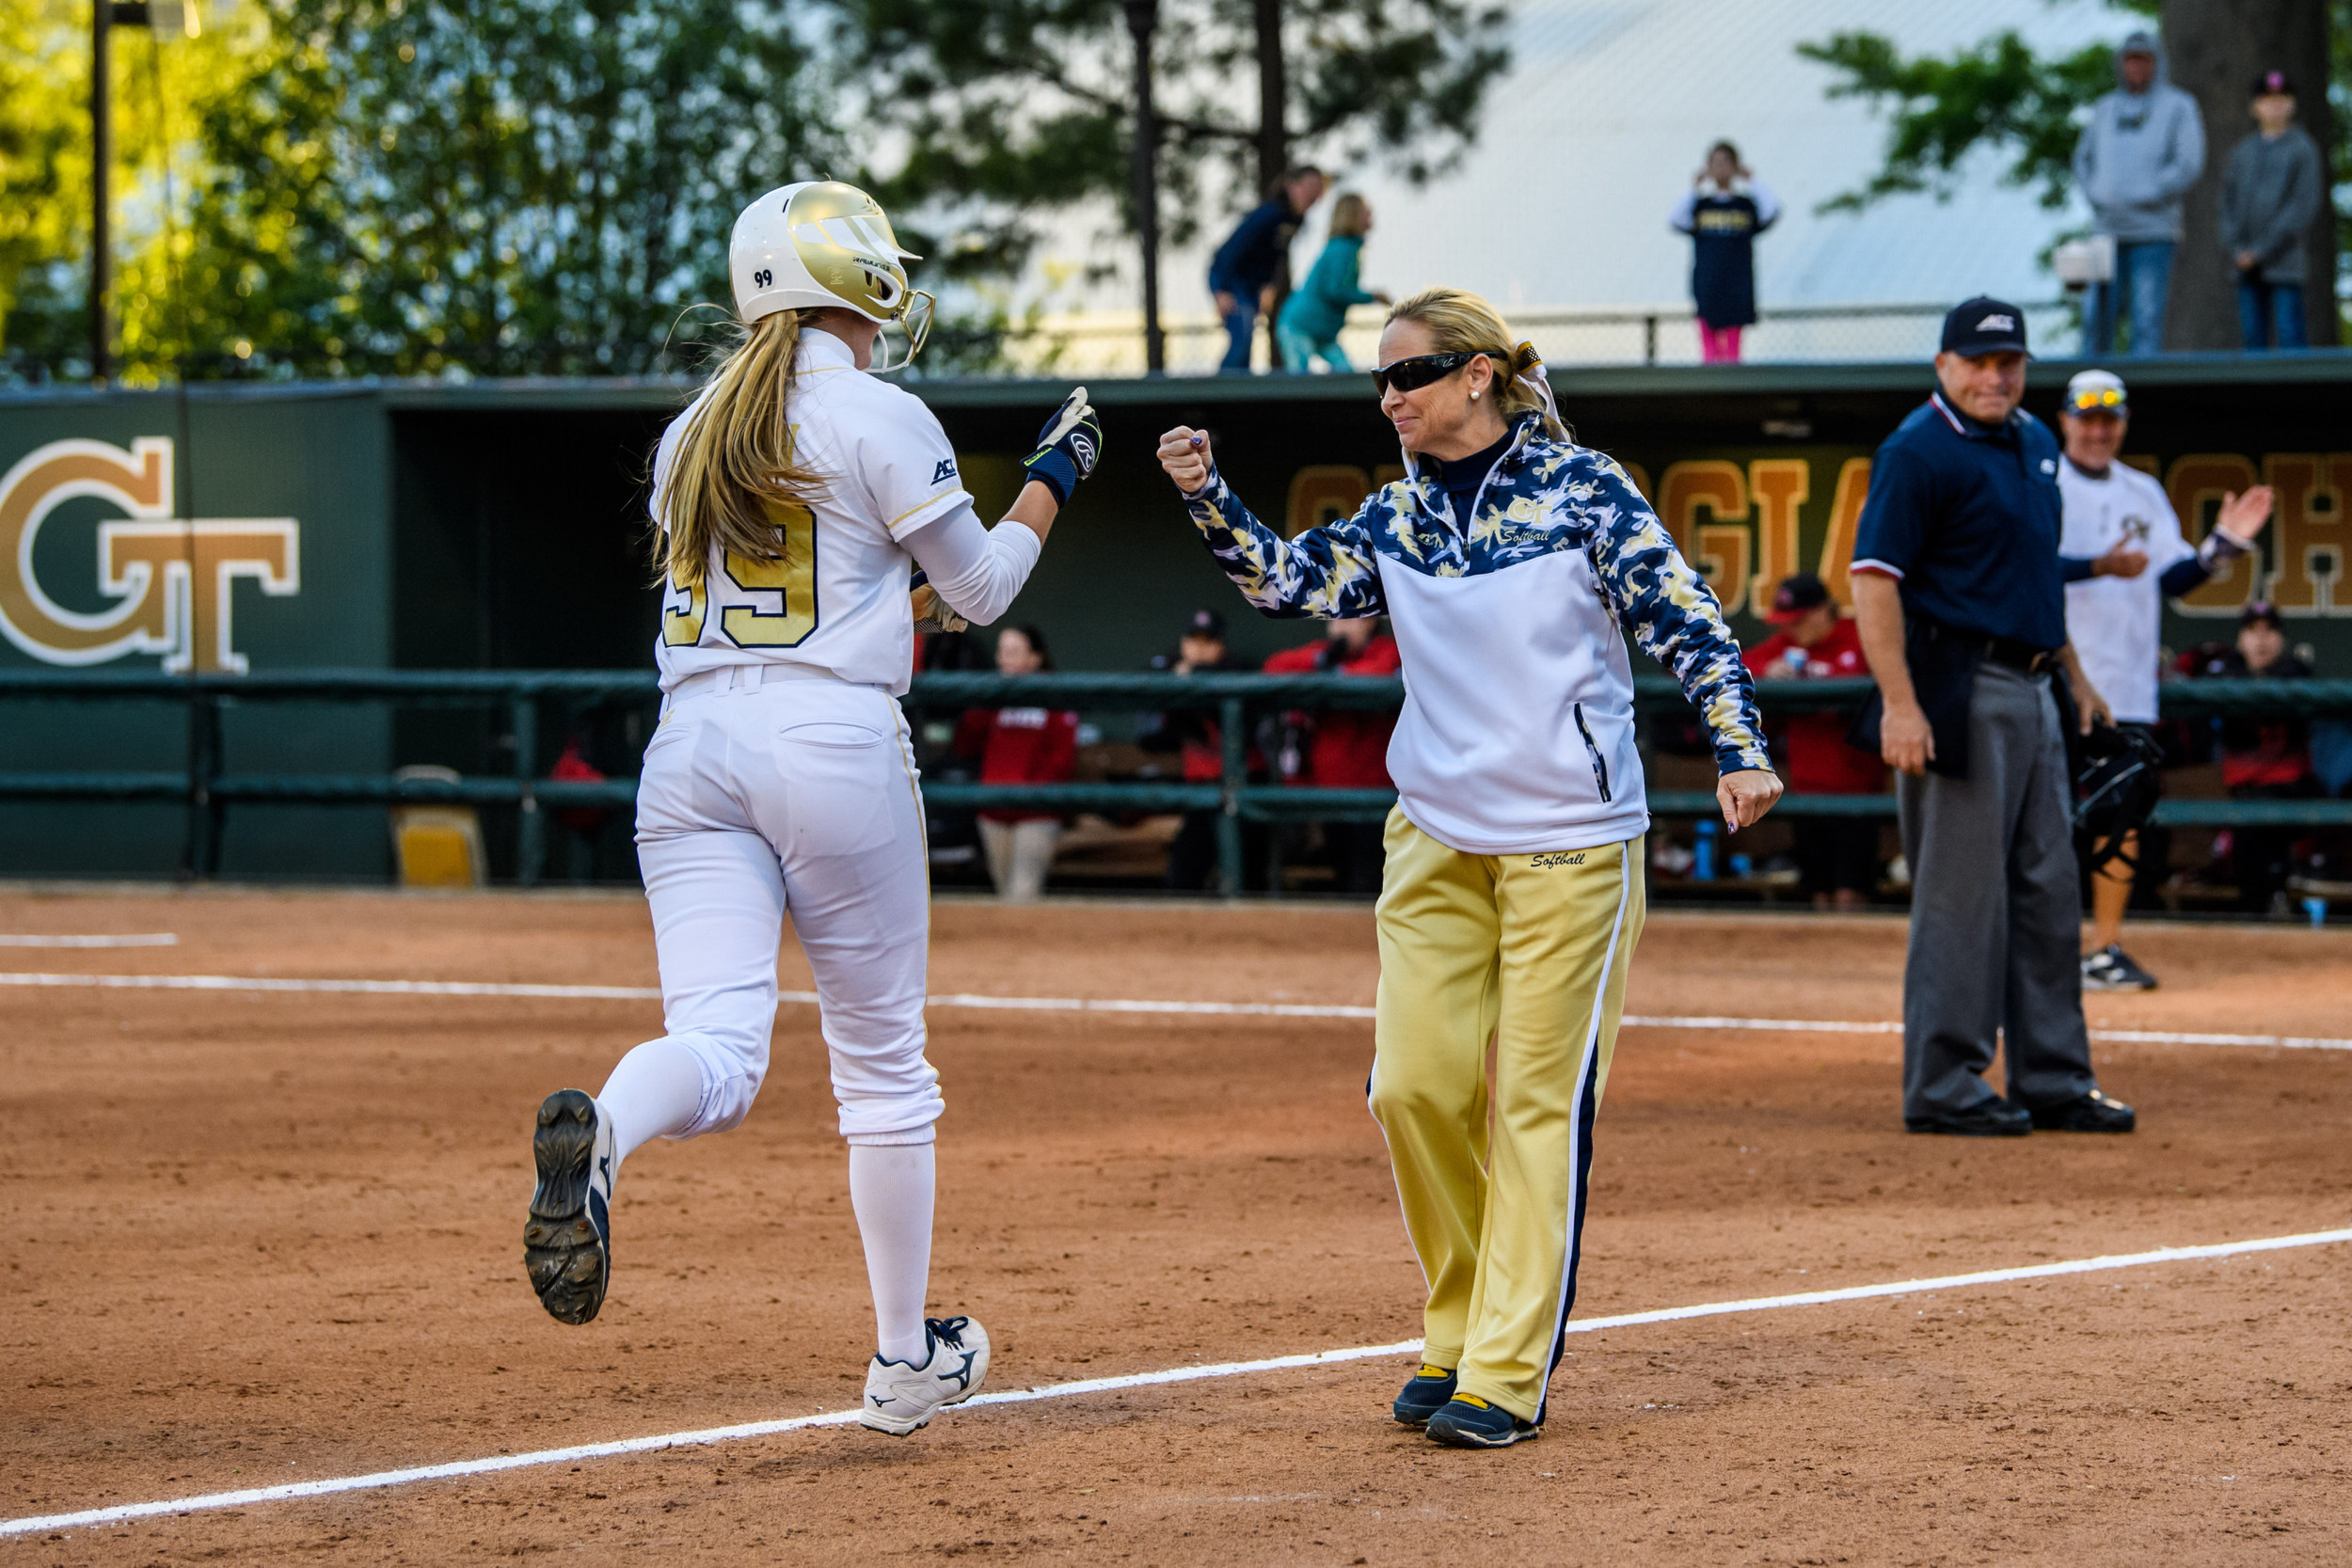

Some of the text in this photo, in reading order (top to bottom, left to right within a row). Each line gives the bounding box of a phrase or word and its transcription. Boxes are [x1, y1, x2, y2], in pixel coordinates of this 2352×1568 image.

[754, 269, 772, 288] 99
[1502, 528, 1550, 546] Softball
[0, 436, 299, 676] GT
[1531, 852, 1585, 869] Softball
